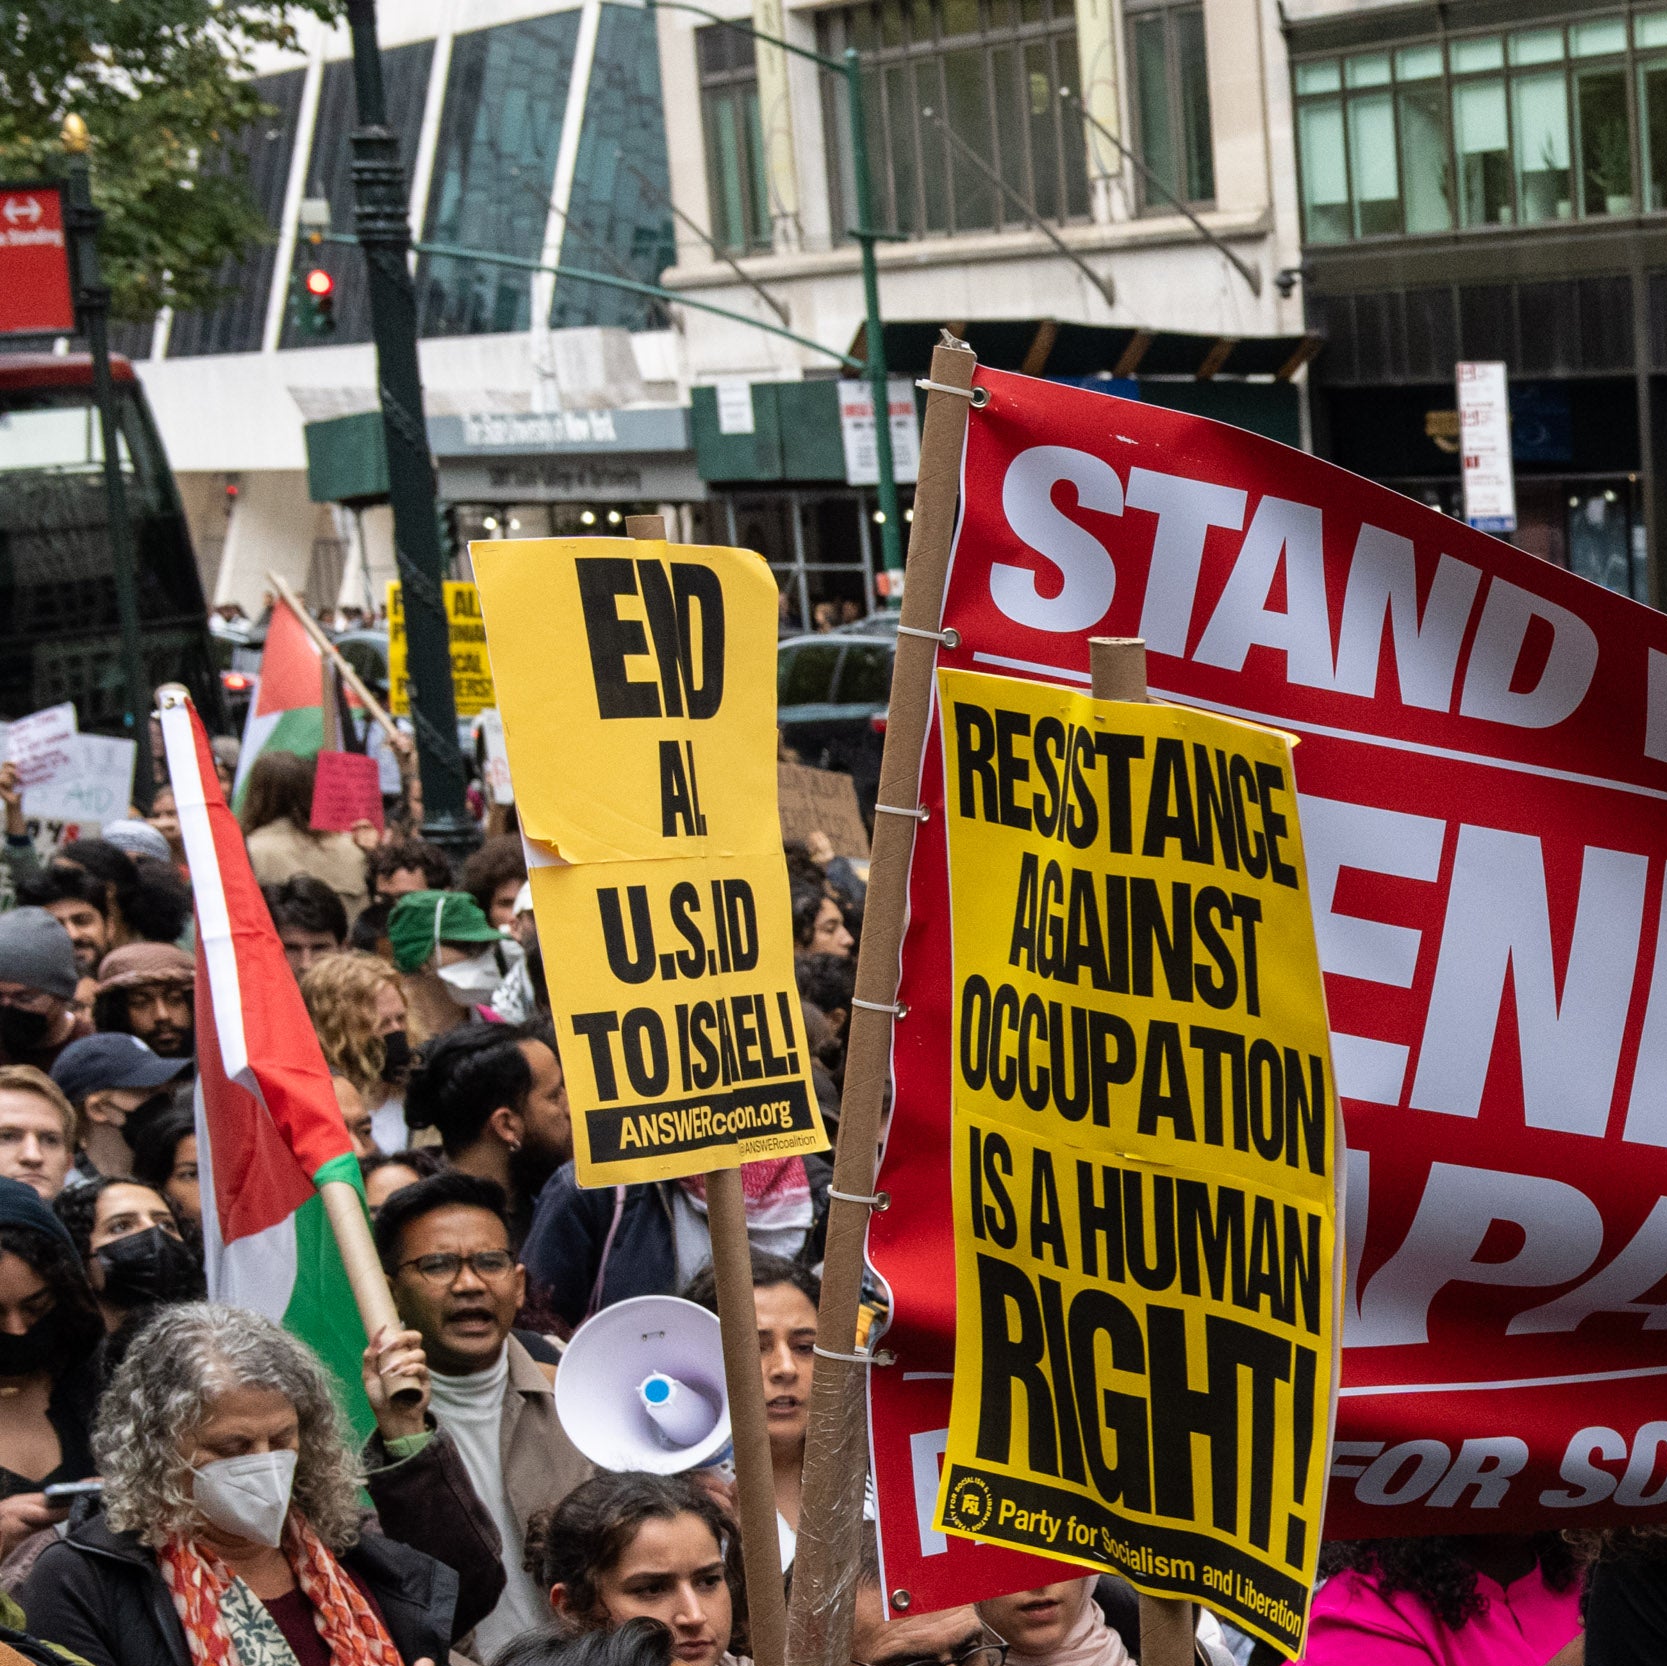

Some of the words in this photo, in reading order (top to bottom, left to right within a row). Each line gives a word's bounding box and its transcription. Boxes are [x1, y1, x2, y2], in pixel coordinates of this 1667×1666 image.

[989, 444, 1600, 730] STAND
[953, 700, 1300, 891] RESISTANCE
[1008, 850, 1263, 1018] AGAINST
[571, 1006, 671, 1102] TO
[959, 974, 1327, 1177] OCCUPATION
[969, 1125, 1018, 1250] IS
[1030, 1147, 1069, 1269] A
[1076, 1160, 1322, 1337] HUMAN
[975, 1251, 1318, 1573] RIGHT!
[1330, 1437, 1530, 1510] FOR
[997, 1499, 1061, 1544] Party
[1066, 1514, 1098, 1548] for
[1101, 1525, 1196, 1583] Socialism
[1202, 1560, 1233, 1594] and
[1235, 1571, 1302, 1639] Liberation
